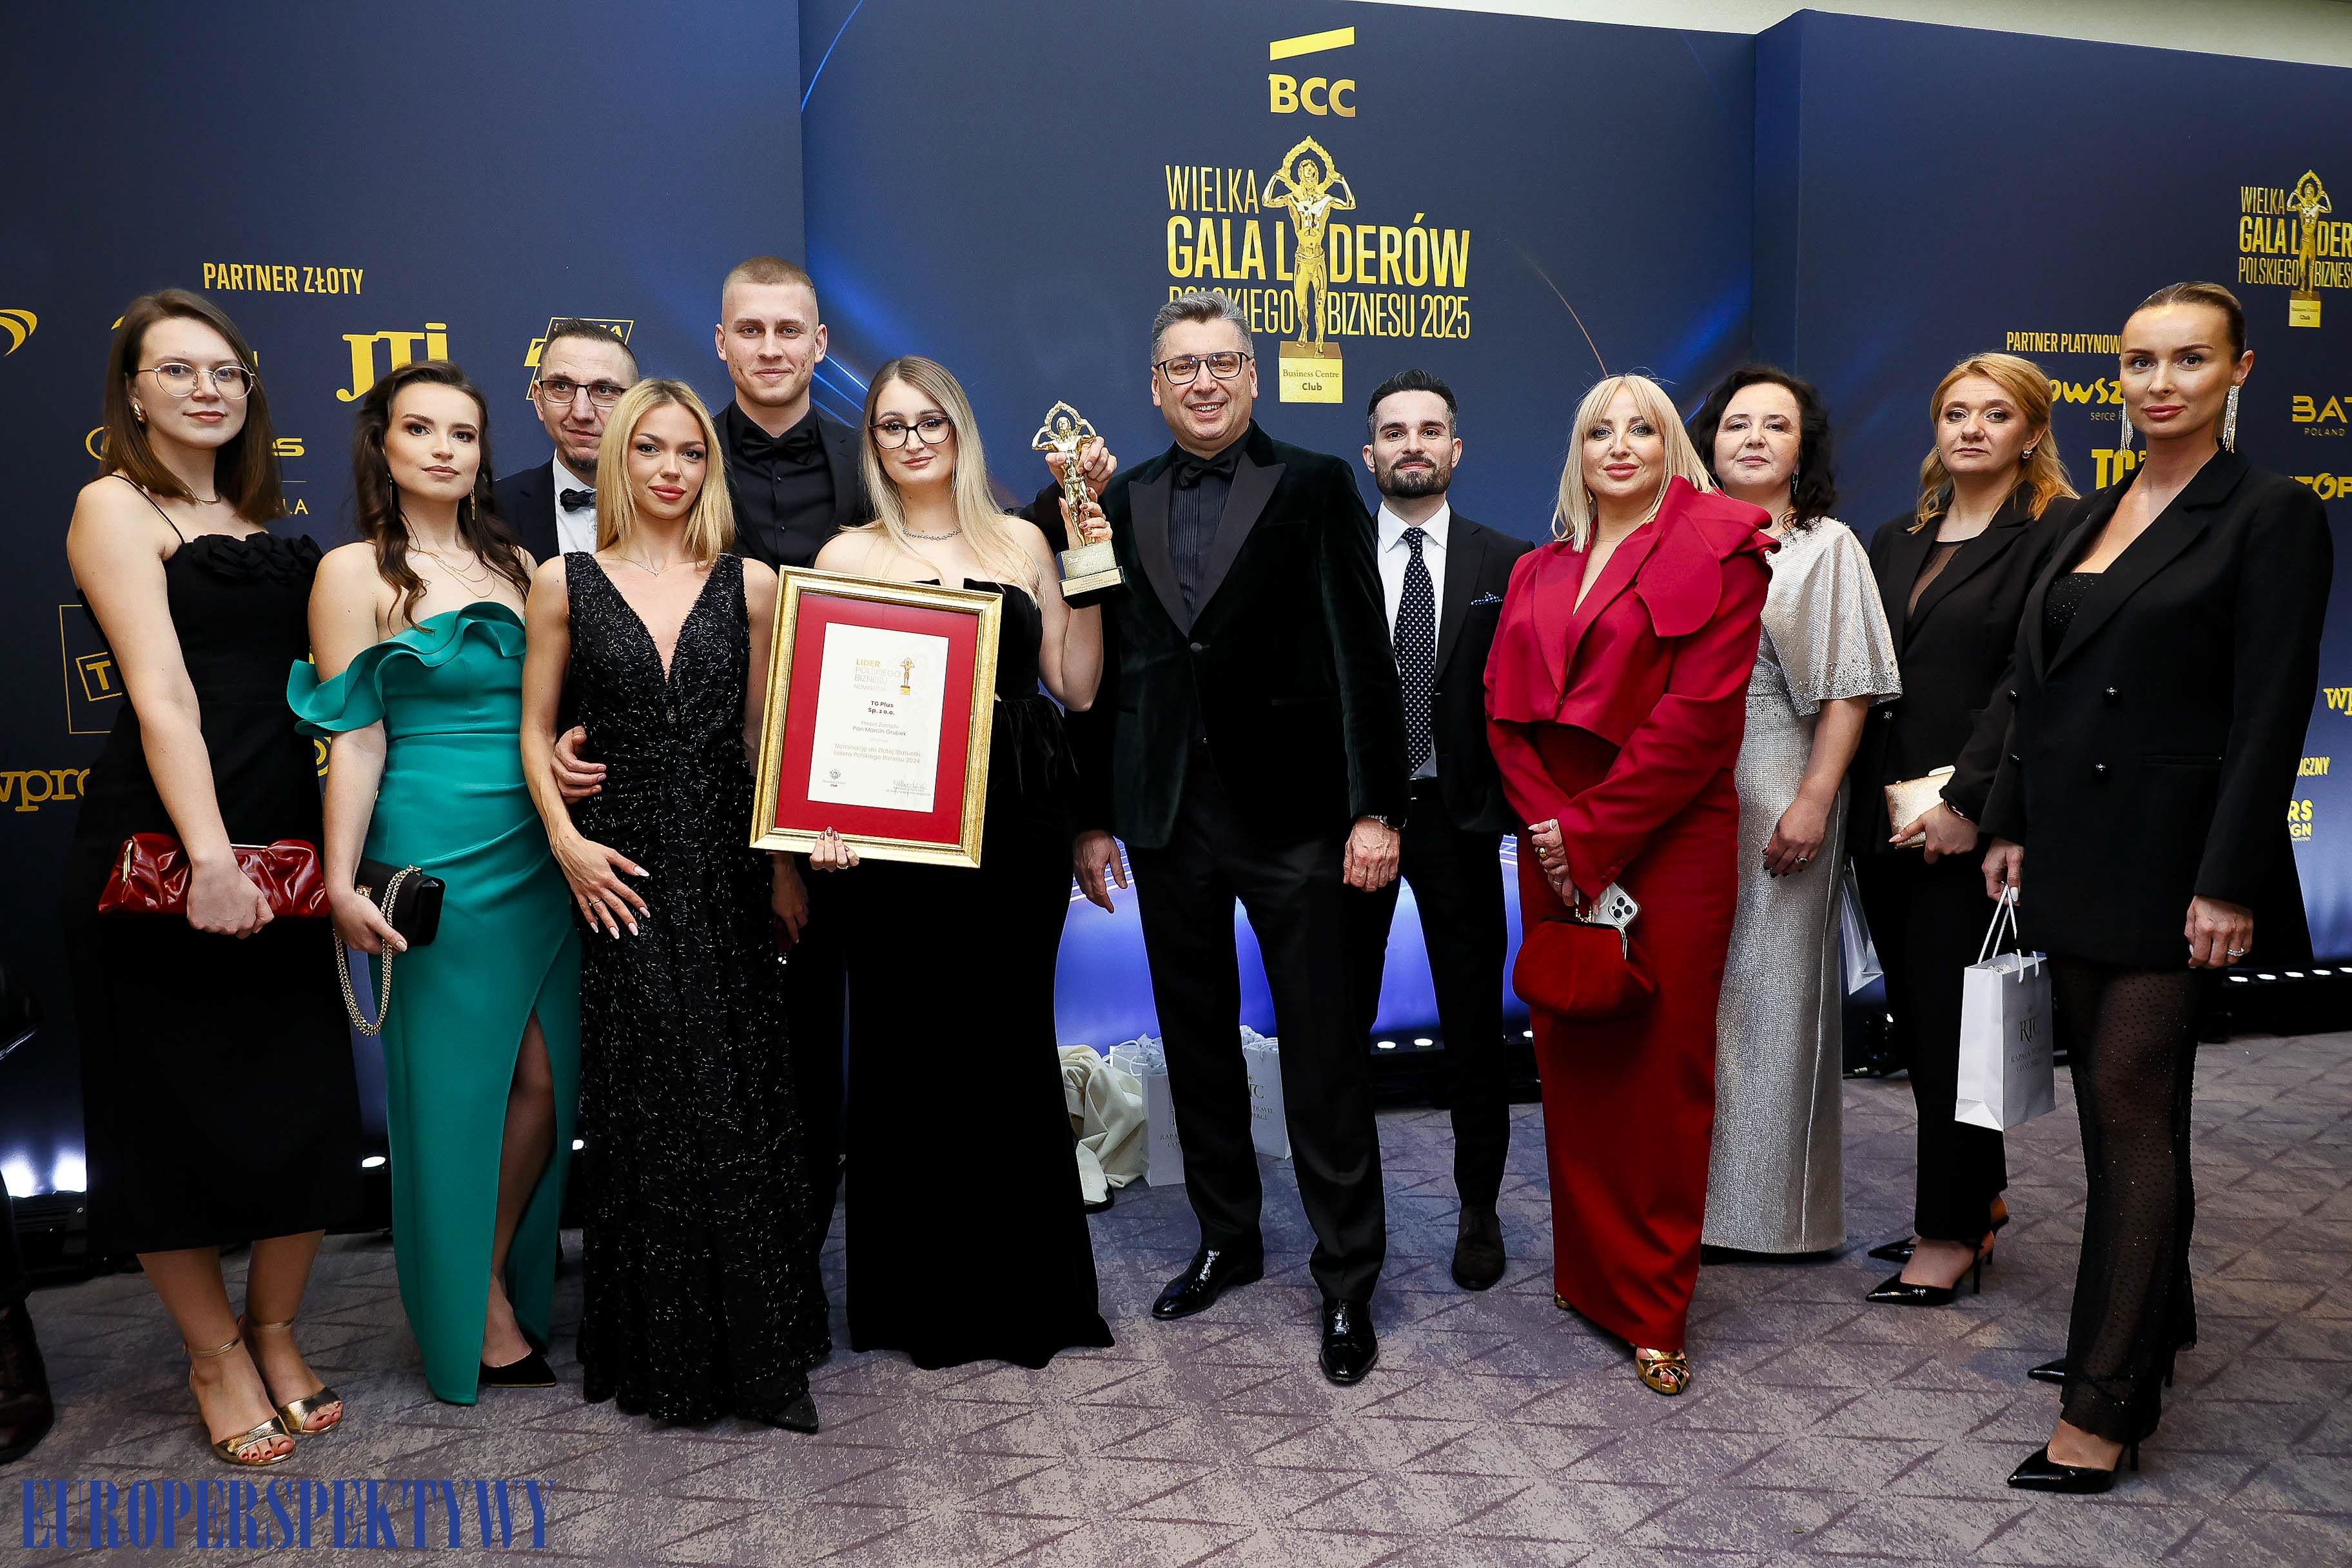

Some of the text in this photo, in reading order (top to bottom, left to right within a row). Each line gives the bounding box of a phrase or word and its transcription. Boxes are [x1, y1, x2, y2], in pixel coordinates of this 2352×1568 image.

[1268, 73, 1357, 117] BCC
[1165, 164, 1260, 215] WIELKA
[2240, 186, 2286, 215] WIELKA
[1166, 215, 1266, 280] GALA
[2239, 215, 2287, 254] GALA
[202, 262, 364, 295] PARTNER ZŁOTY
[2238, 256, 2300, 286] POLSKIEGO
[1327, 291, 1415, 338] BIZNESU
[1420, 295, 1470, 340] 2025
[2006, 331, 2058, 352] PARTNER
[1282, 369, 1340, 378] Business Centre
[1302, 382, 1322, 391] Club
[2090, 413, 2115, 421] serce
[2304, 427, 2346, 436] POLAND
[856, 658, 881, 668] LIDER
